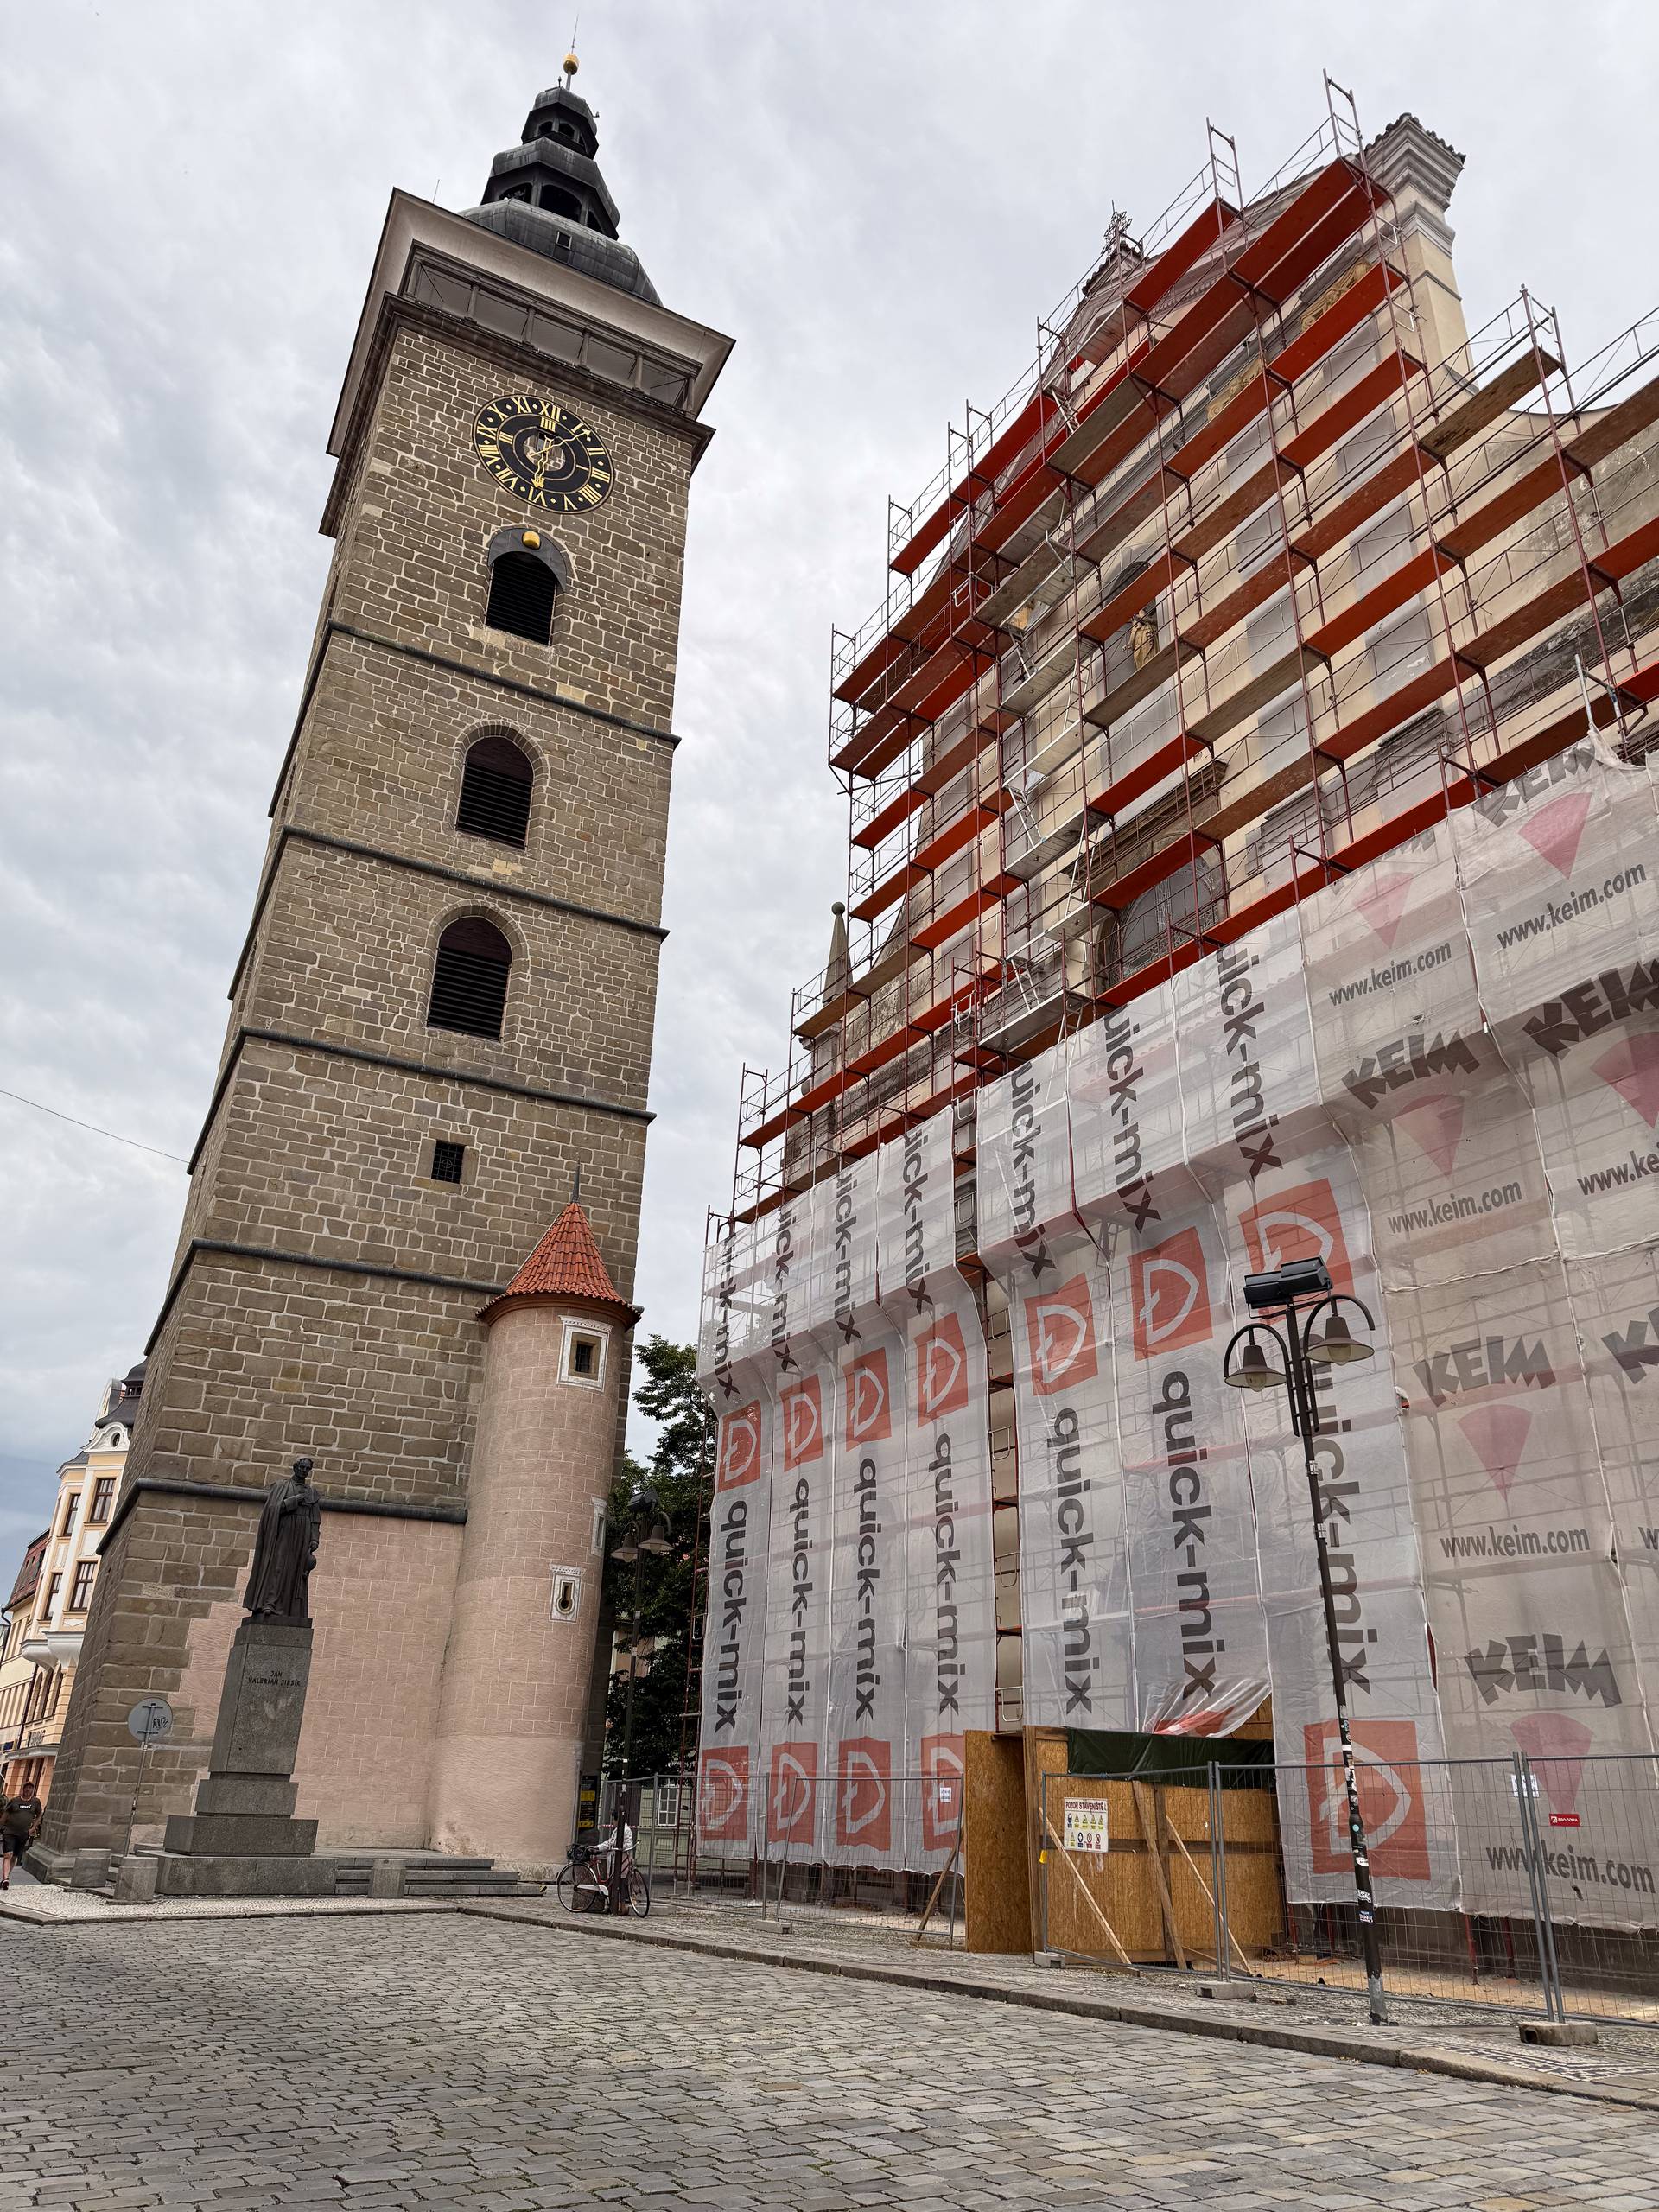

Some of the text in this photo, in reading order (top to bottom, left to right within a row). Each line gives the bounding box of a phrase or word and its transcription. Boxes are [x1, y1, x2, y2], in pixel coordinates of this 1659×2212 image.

[477, 421, 498, 439] IX
[487, 403, 509, 421] X
[511, 397, 532, 413] XI
[539, 400, 561, 422] XII
[540, 417, 556, 431] IIII
[571, 423, 584, 433] I
[479, 444, 500, 466] VIII
[499, 431, 513, 444] III
[495, 467, 518, 491] VII
[528, 486, 547, 507] VI
[564, 494, 577, 510] V
[578, 484, 602, 505] IIII
[591, 467, 610, 483] III
[1497, 863, 1646, 949] www.keim.com
[1328, 943, 1452, 1006] www.keim.com
[1216, 946, 1283, 1181] uick-mix
[1341, 1030, 1481, 1110] KEIM
[1103, 1004, 1161, 1234] uick-mix
[1011, 1061, 1057, 1279] uick-mix
[1577, 1142, 1659, 1196] www.ke
[902, 1129, 933, 1315] uick-mix
[1388, 1179, 1522, 1235] www.keim.com
[1413, 1335, 1556, 1407] KEIM
[1046, 1408, 1100, 1715] quick-mix
[1152, 1371, 1225, 1700] quick-mix
[1440, 1525, 1591, 1558] www.keim.com
[854, 1458, 881, 1722] quick-mix
[928, 1433, 966, 1716] quick-mix
[715, 1500, 748, 1732] quick-mix
[787, 1478, 813, 1726] quick-mix
[248, 1677, 278, 1686] VALERIAN
[1464, 1633, 1622, 1708] KEIM
[1065, 1802, 1078, 1810] POZOR
[1486, 1839, 1656, 1894] wwwkeim.com
